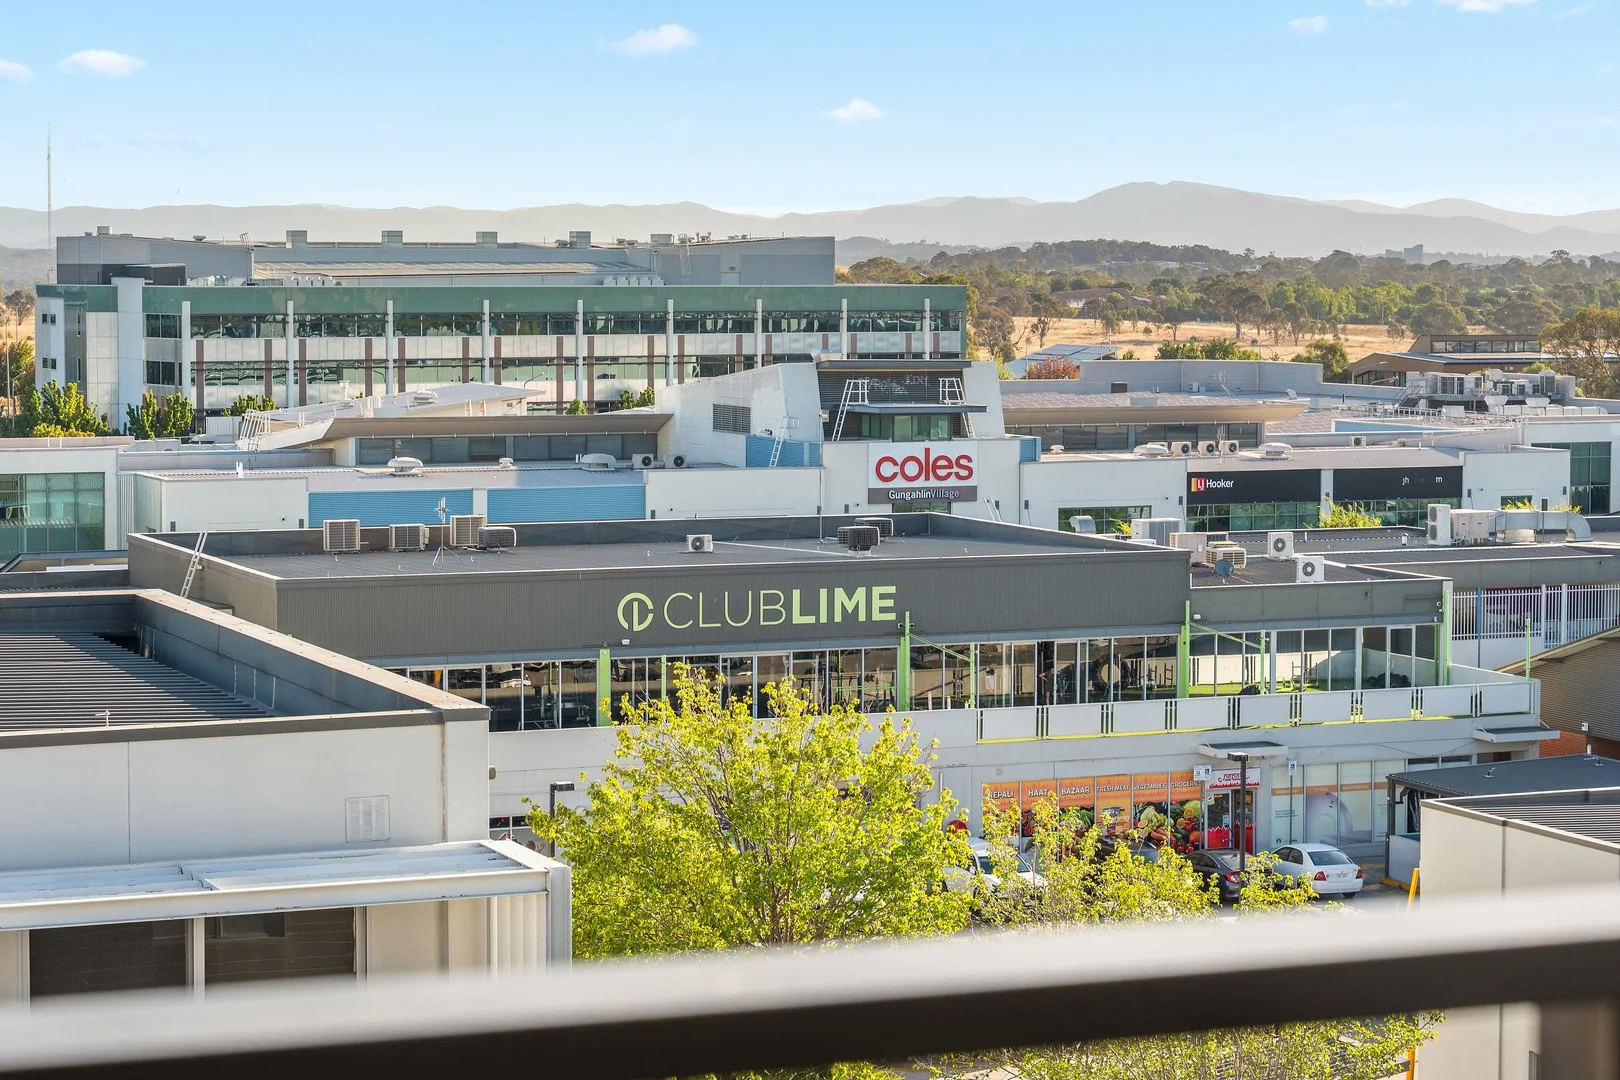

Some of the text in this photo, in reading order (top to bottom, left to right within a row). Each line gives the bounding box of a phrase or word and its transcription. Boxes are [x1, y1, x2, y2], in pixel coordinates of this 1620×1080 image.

[875, 447, 974, 483] coles
[1206, 478, 1234, 488] Hooker
[1134, 782, 1166, 790] VEGETABLES
[1028, 788, 1048, 797] HAAT
[1061, 786, 1090, 795] BAZAAR
